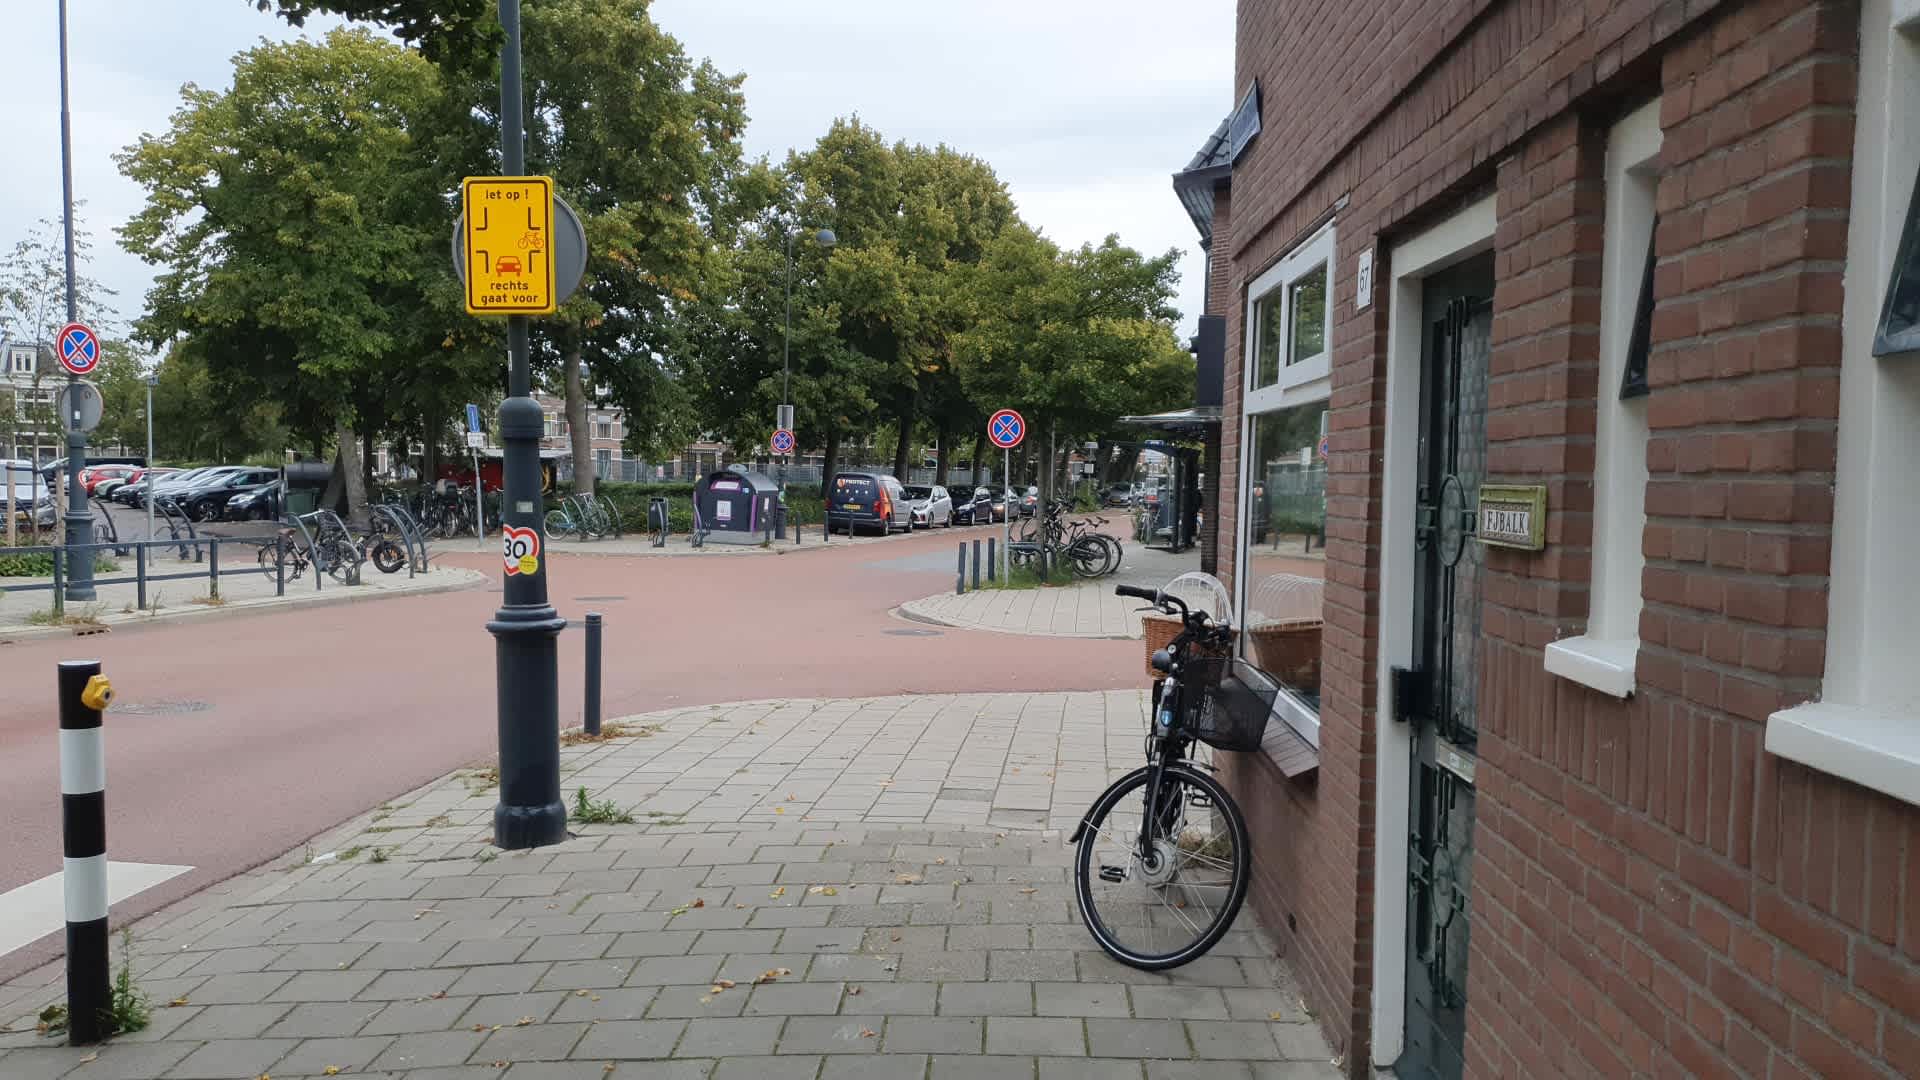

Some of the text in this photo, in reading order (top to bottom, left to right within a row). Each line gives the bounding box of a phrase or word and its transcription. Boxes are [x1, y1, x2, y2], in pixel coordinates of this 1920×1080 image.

[485, 190, 501, 200] let
[506, 191, 520, 201] op
[1360, 265, 1369, 292] 67
[490, 280, 529, 290] rechts
[481, 294, 538, 305] gaat voor
[504, 538, 527, 560] 30
